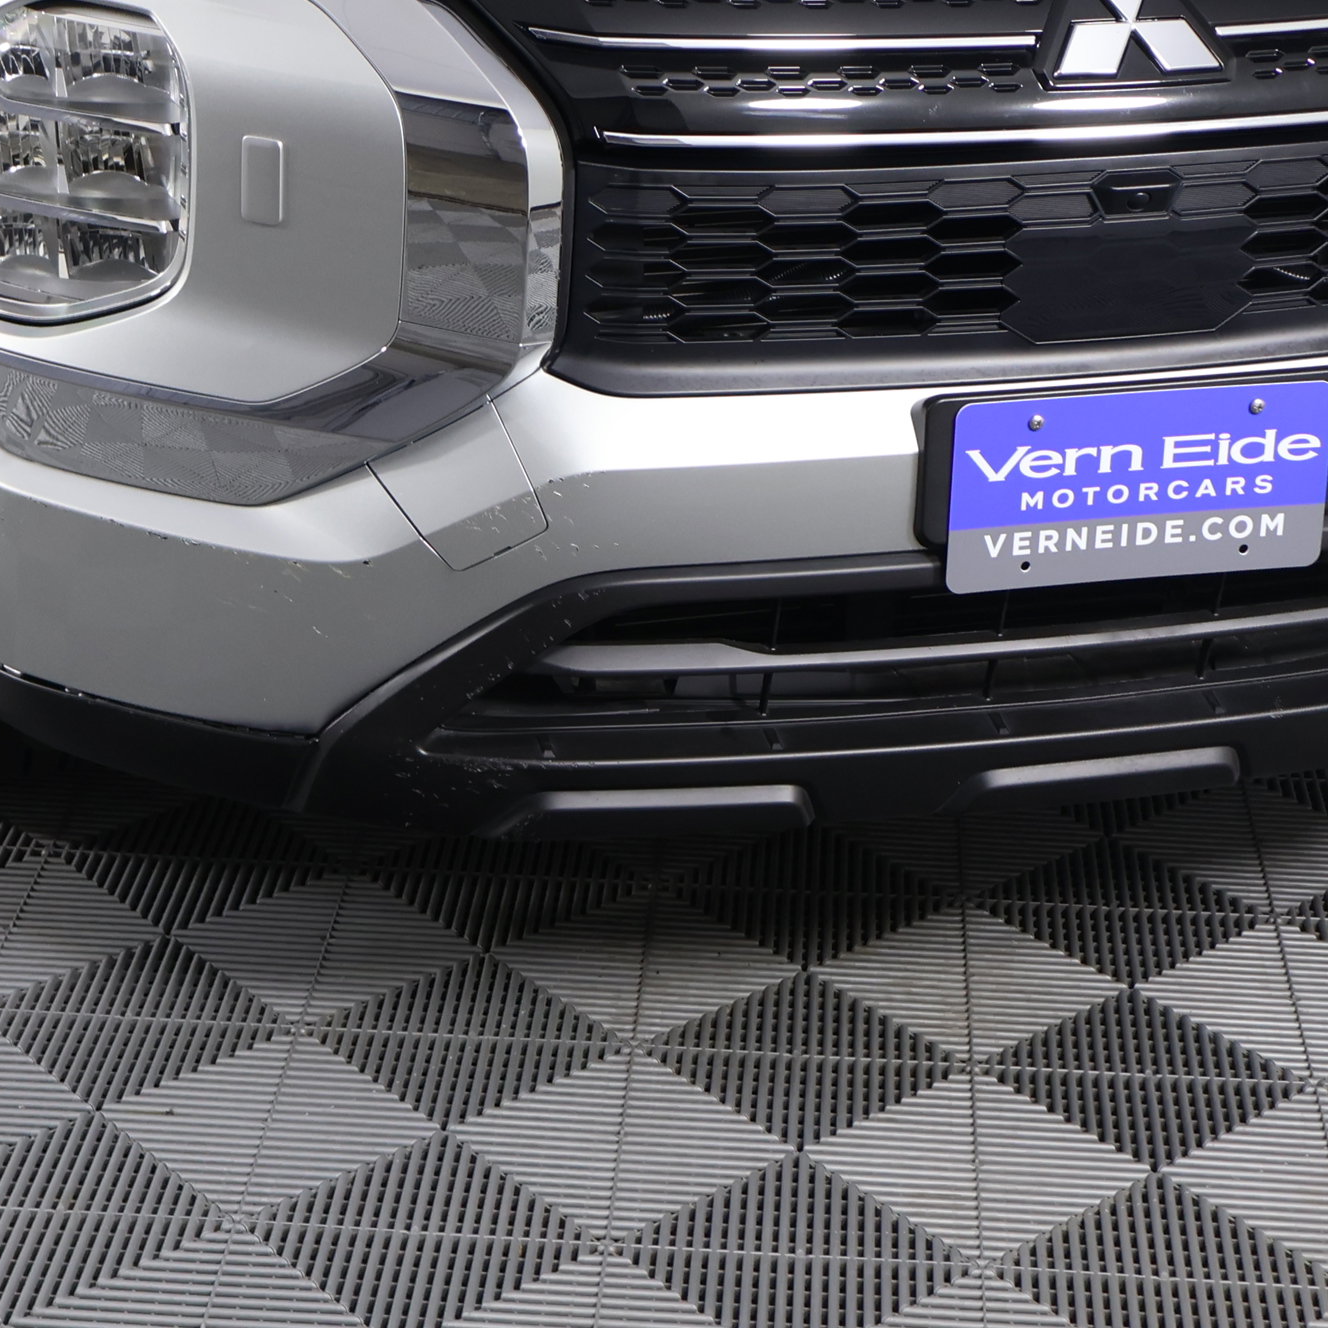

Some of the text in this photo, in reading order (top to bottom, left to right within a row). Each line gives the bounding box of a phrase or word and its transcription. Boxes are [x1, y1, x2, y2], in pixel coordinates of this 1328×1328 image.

[965, 428, 1322, 483] Vern Eide
[1020, 474, 1274, 512] MOTORCARS
[984, 512, 1285, 559] VERNEIDE.COM
